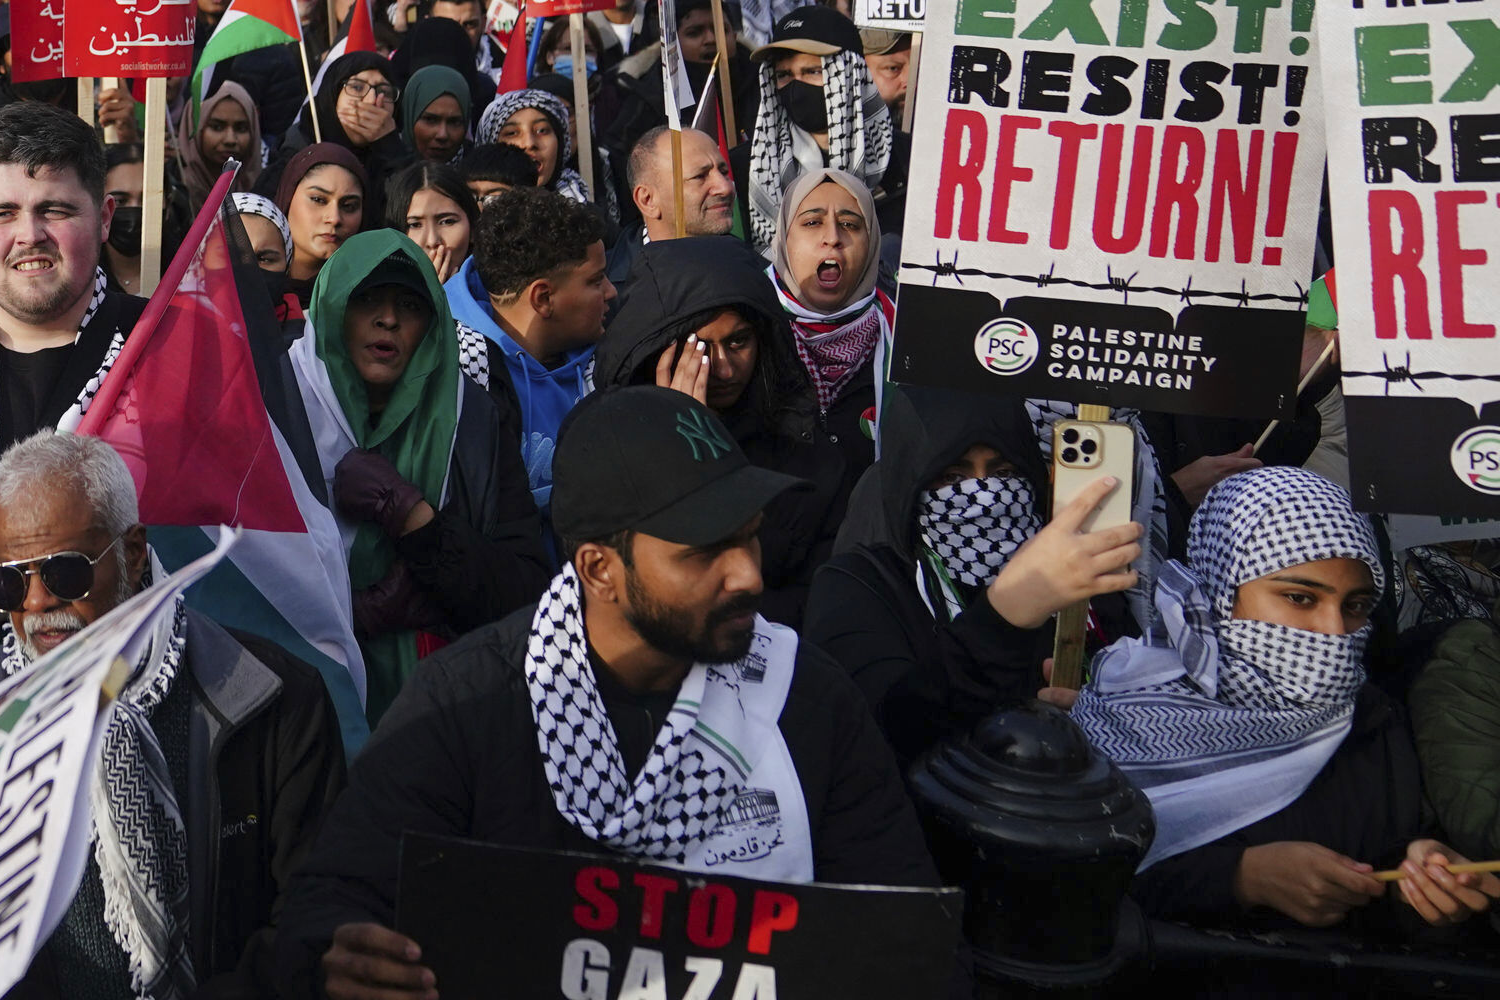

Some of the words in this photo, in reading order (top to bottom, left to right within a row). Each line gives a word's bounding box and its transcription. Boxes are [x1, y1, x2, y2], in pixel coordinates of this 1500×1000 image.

[121, 61, 186, 71] socialistworker.co.uk
[947, 45, 1309, 127] RESIST!
[933, 108, 1301, 268] RETURN!
[1364, 188, 1500, 340] RE
[989, 335, 1026, 360] PSC
[1049, 343, 1217, 372] SOLIDARITY
[1052, 323, 1203, 352] PALESTINE
[1047, 362, 1193, 391] CAMPAIGN
[573, 865, 799, 955] STOP
[560, 938, 777, 1000] GAZA
